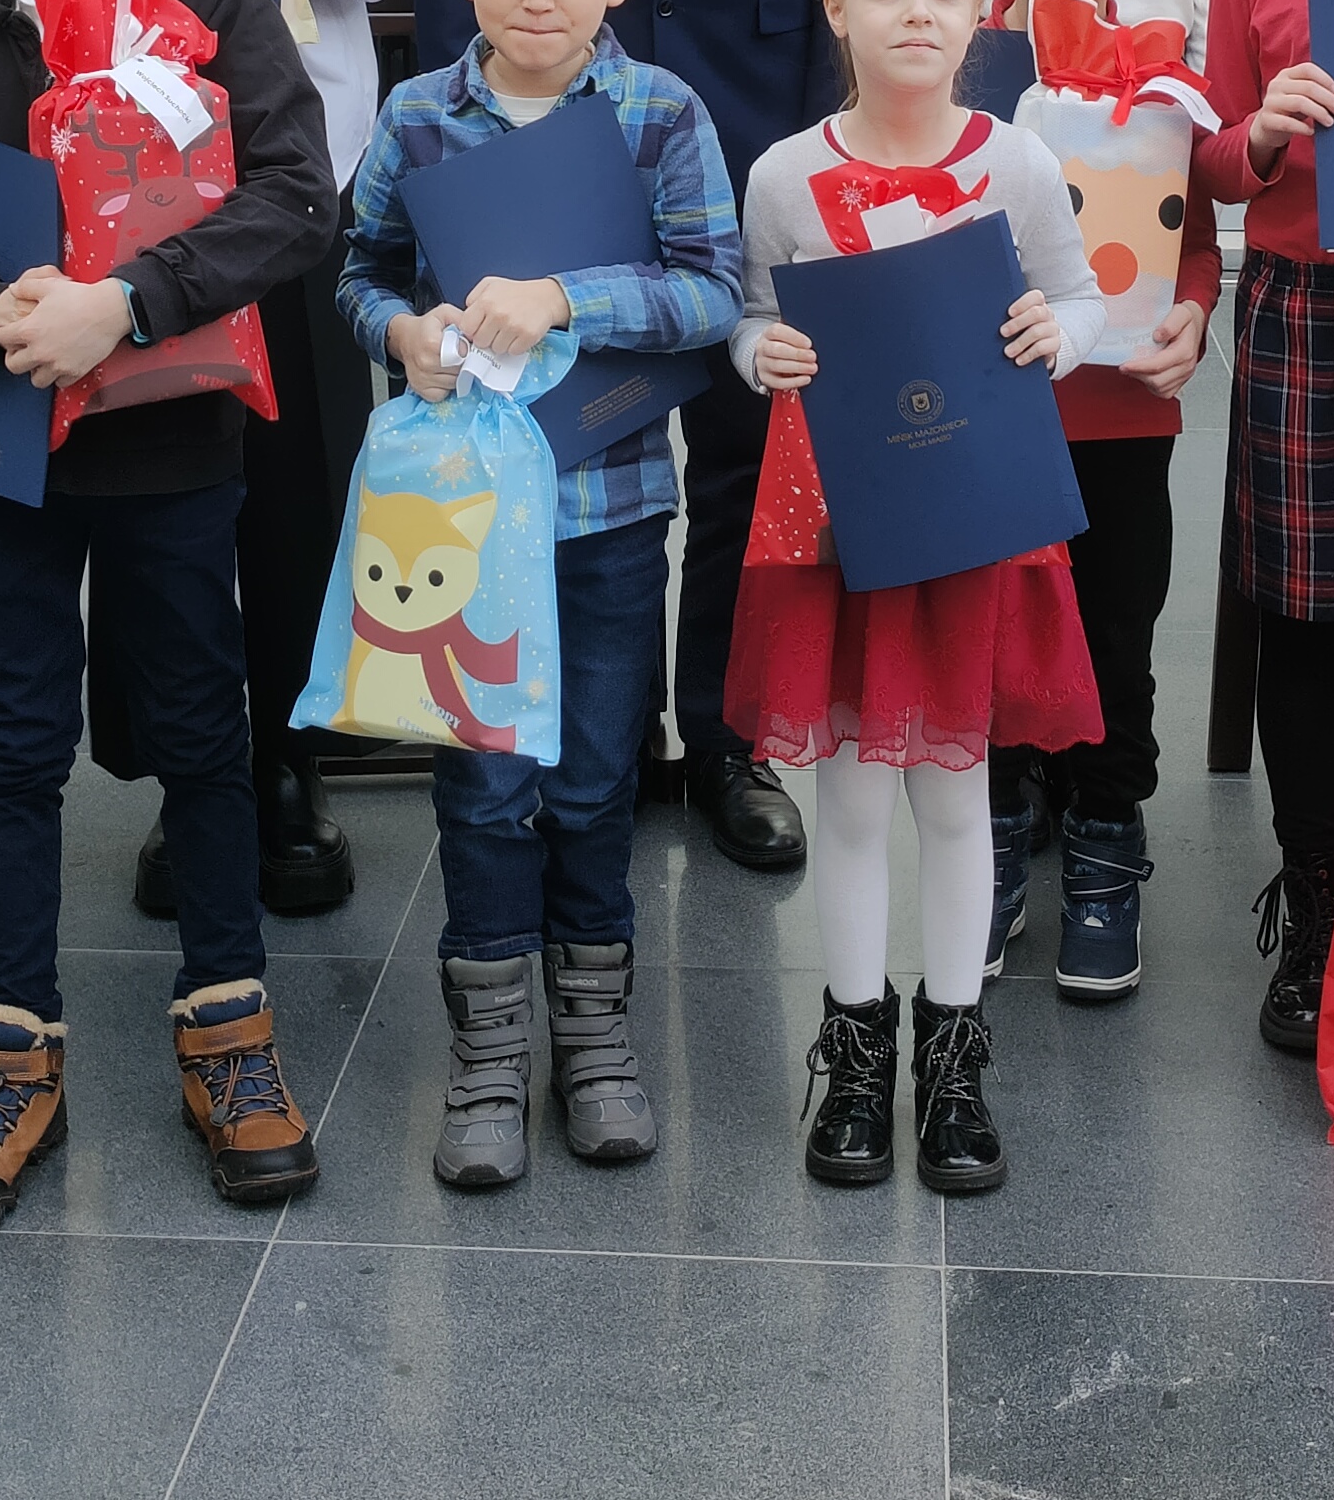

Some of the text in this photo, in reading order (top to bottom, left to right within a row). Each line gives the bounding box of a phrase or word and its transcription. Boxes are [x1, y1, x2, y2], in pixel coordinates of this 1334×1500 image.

[136, 70, 192, 124] Wojciech Suchocki
[419, 696, 462, 729] MERRY
